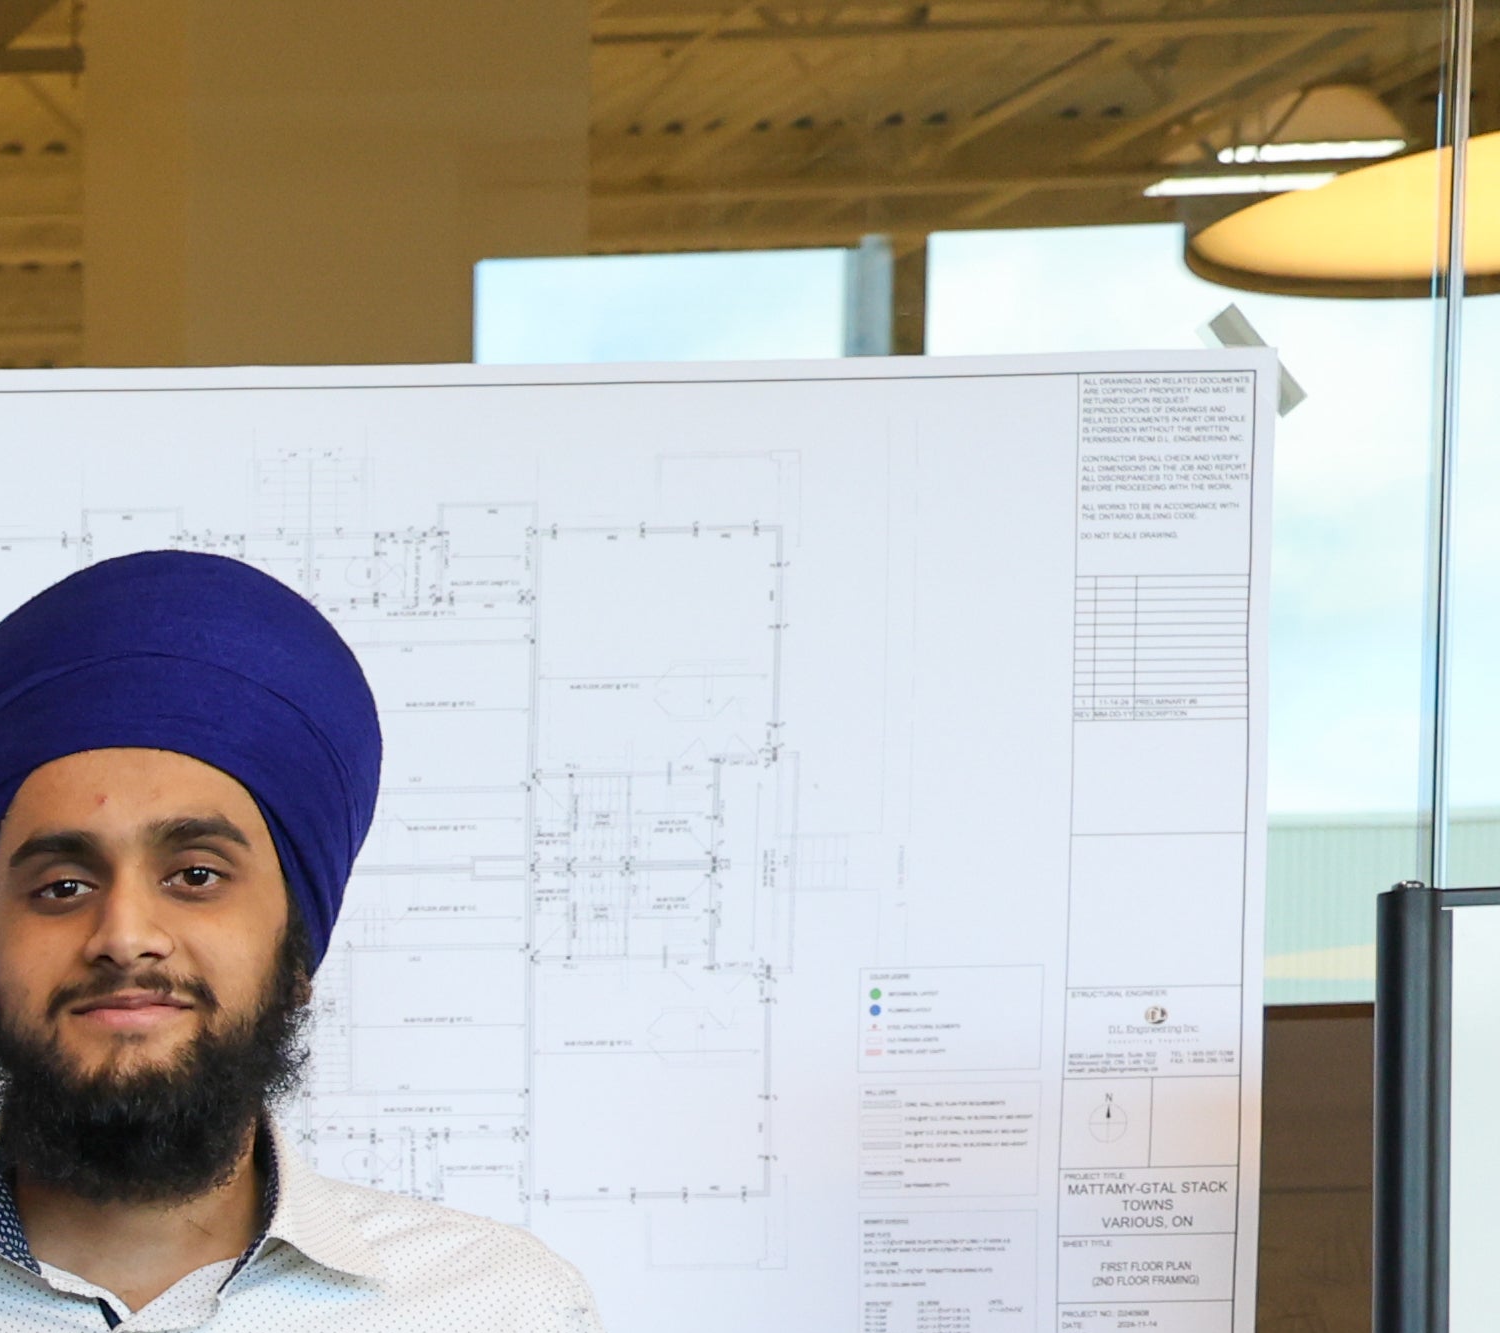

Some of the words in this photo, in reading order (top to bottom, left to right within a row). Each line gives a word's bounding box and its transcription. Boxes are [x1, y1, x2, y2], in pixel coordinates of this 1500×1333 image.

[1068, 1183, 1177, 1195] MATTAMY-GTAL
[1181, 1181, 1228, 1193] STACK
[1122, 1199, 1174, 1211] TOWNS
[1101, 1217, 1168, 1229] VARIOUS,
[1172, 1216, 1193, 1228] ON
